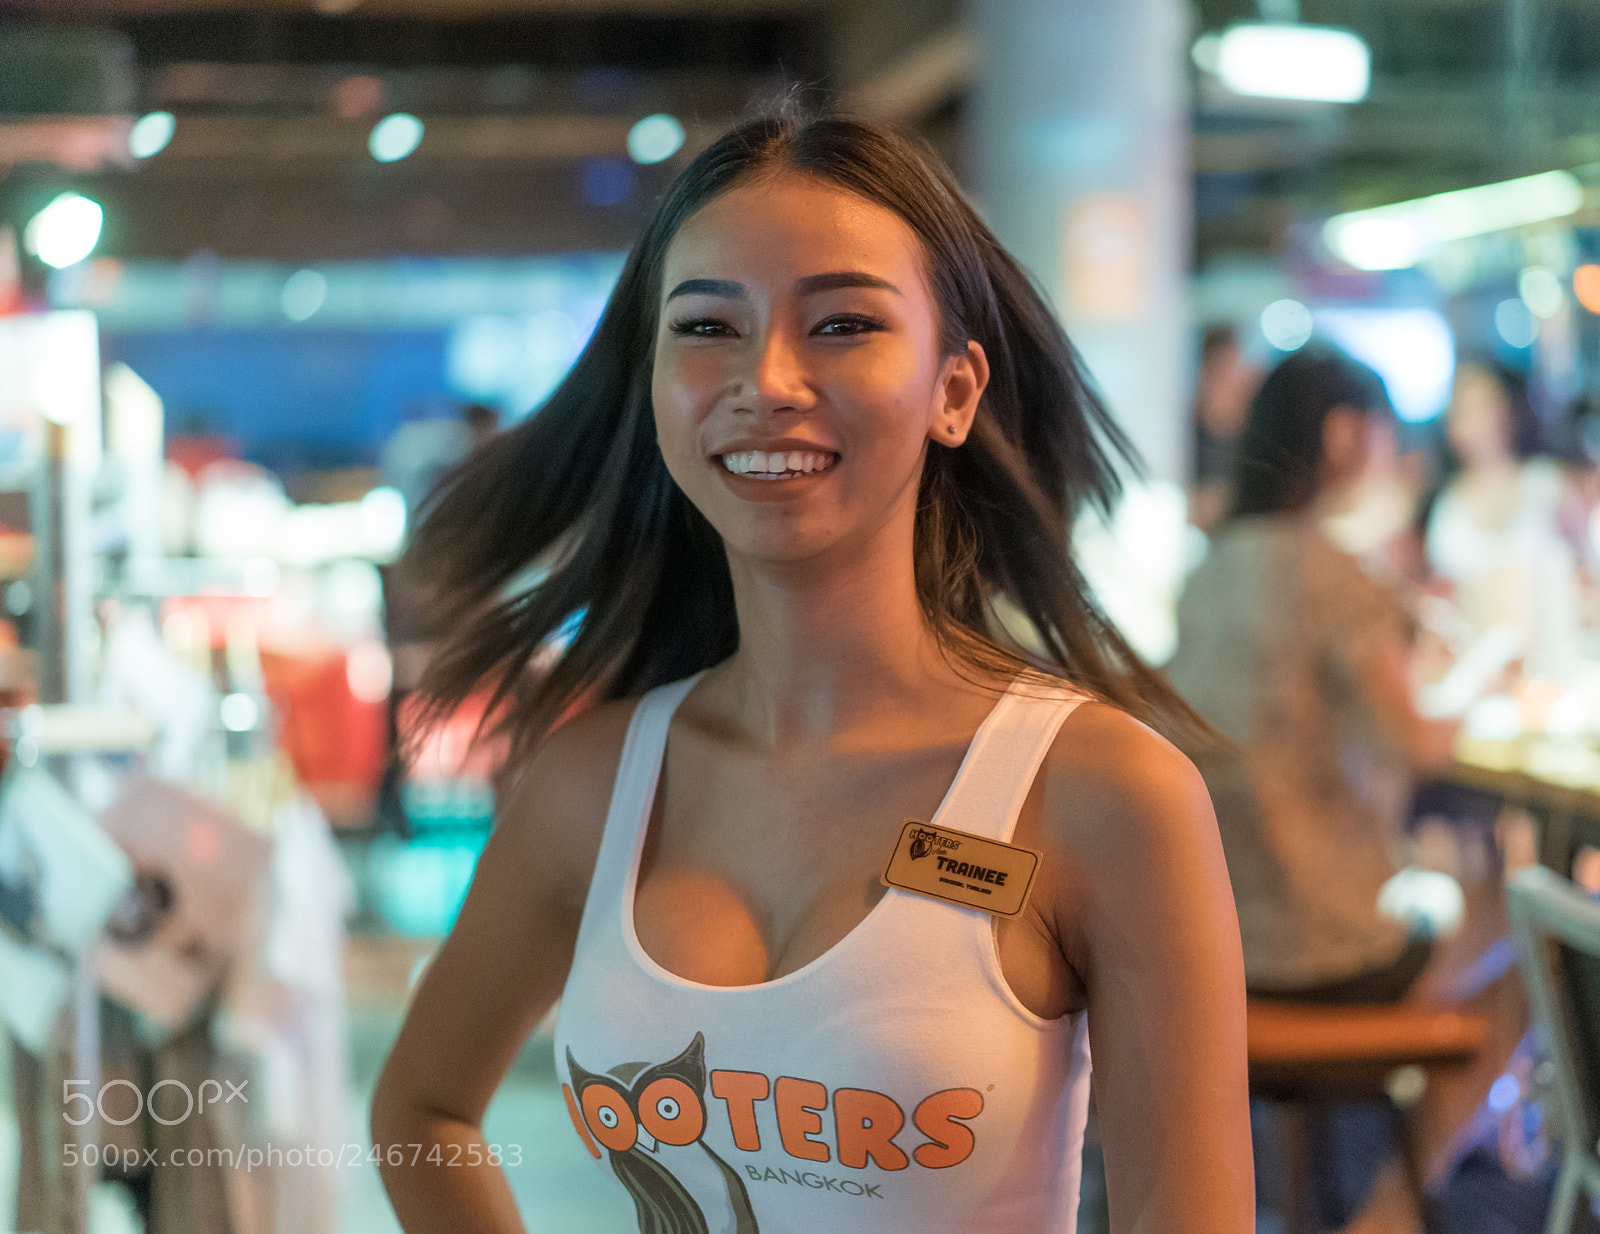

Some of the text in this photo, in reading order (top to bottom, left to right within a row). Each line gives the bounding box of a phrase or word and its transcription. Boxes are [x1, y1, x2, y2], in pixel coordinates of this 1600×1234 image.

[909, 830, 961, 850] HOOTERS
[937, 857, 1008, 886] TRAINEE
[746, 1164, 885, 1200] BANGKOK
